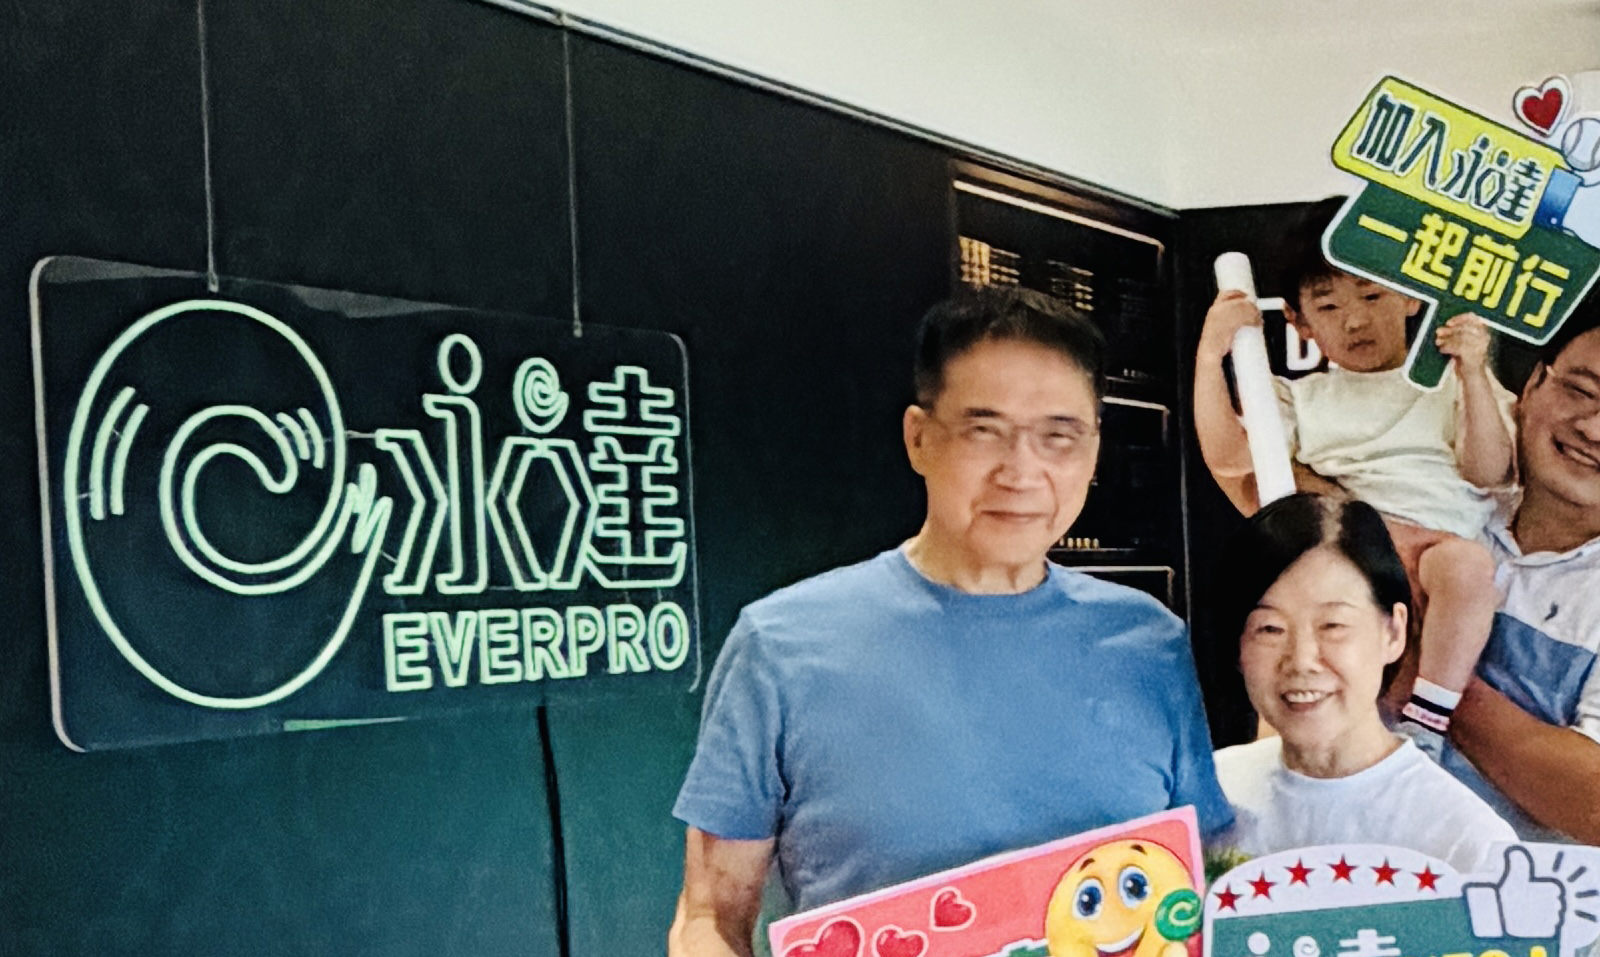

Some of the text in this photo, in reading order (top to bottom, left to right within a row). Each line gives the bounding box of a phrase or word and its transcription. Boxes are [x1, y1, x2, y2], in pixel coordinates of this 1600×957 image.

[1354, 92, 1545, 224] 加入永達
[1357, 213, 1571, 329] 一起前行
[375, 333, 688, 595] 永達
[382, 603, 690, 693] EVERPRO
